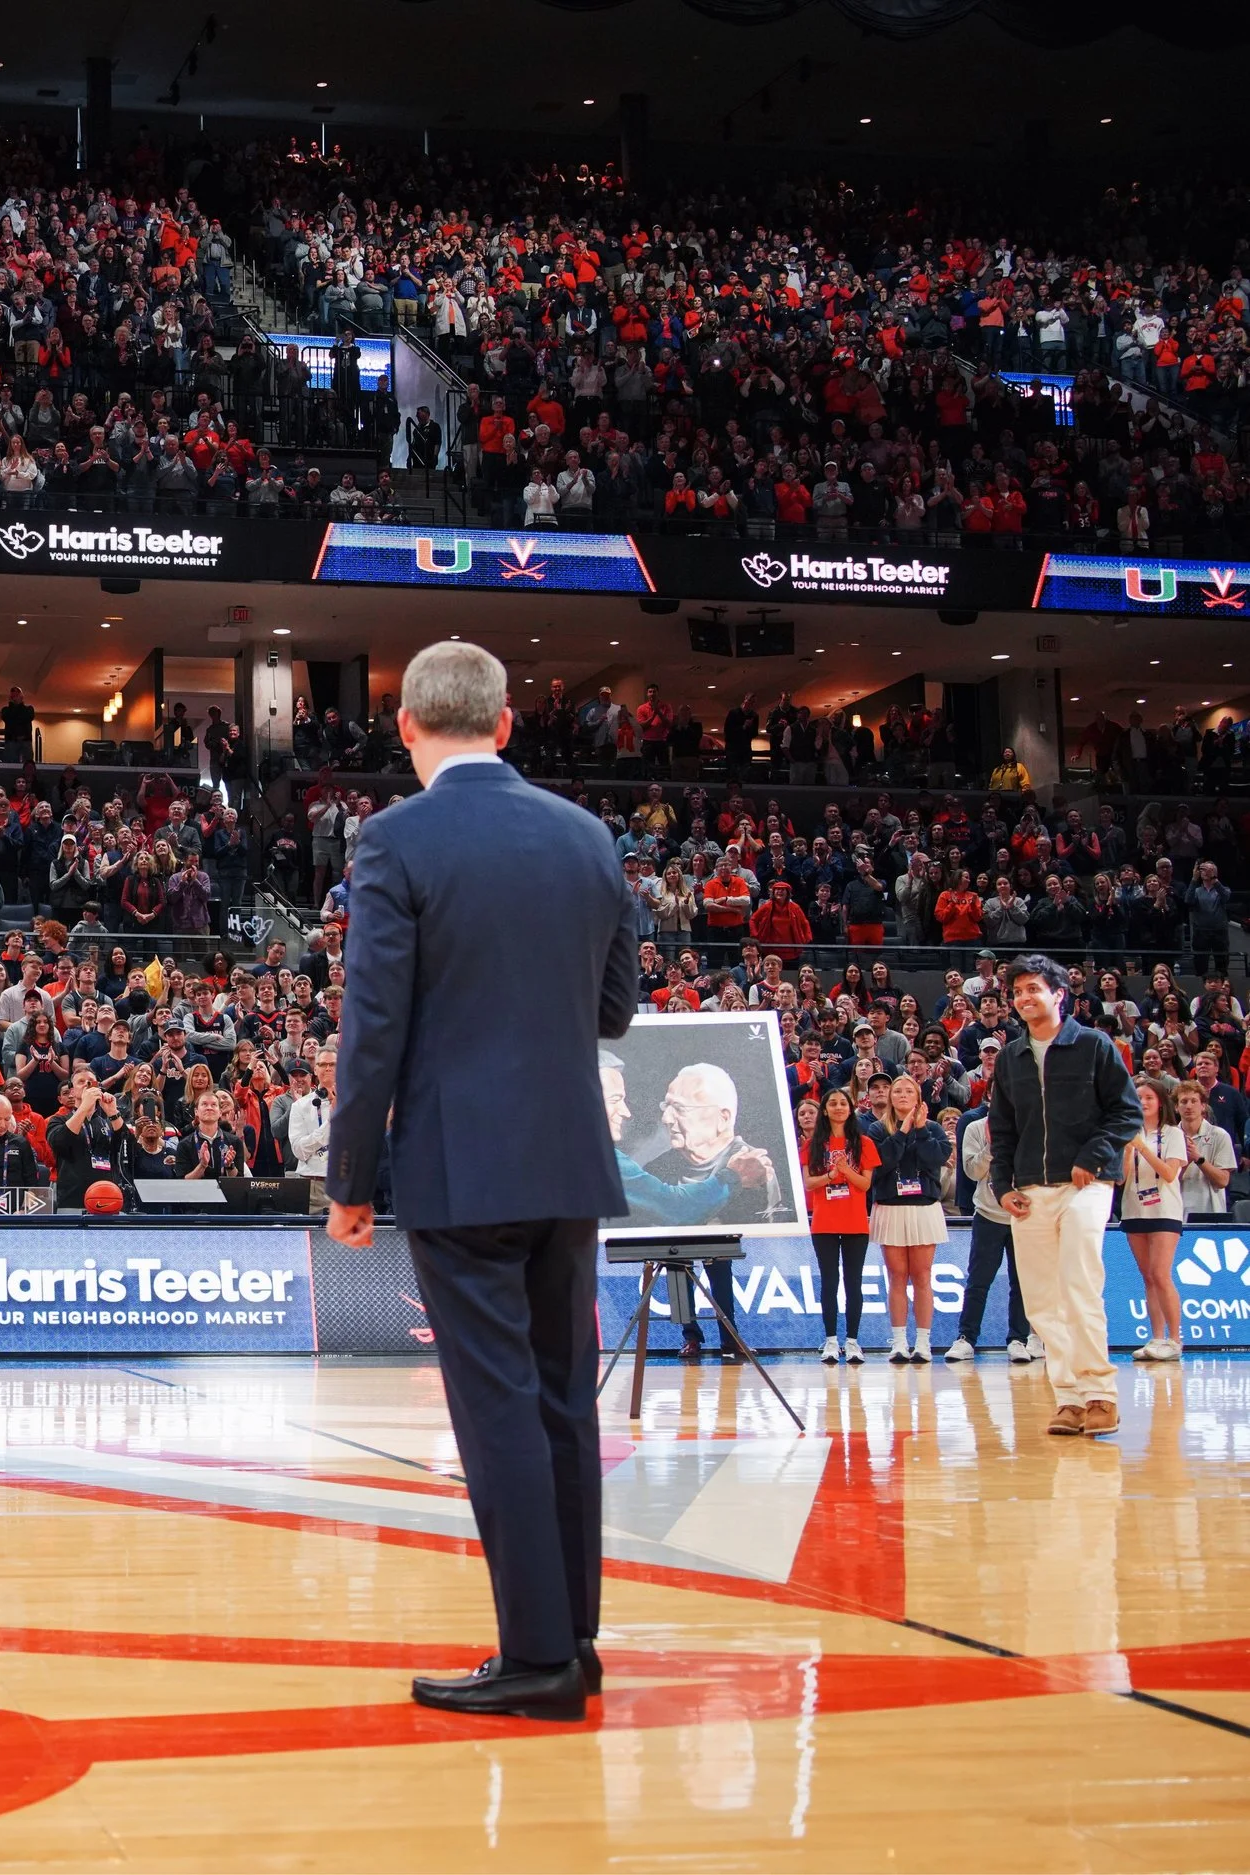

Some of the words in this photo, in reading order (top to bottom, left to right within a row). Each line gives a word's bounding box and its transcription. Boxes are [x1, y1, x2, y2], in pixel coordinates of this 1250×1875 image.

[49, 524, 132, 551] Harris
[50, 552, 78, 561] YOUR
[81, 554, 170, 565] NEIGHBORHOOD
[173, 557, 218, 567] MARKET
[416, 537, 472, 574] U
[790, 554, 867, 580] Harris
[792, 581, 818, 590] YOUR
[821, 582, 902, 593] NEIGHBORHOOD
[905, 585, 945, 595] MARKET
[1125, 568, 1177, 602] U
[233, 609, 249, 621] EXIT
[1041, 639, 1055, 649] EXIT
[33, 1311, 199, 1325] NEIGHBORHOOD
[205, 1311, 286, 1324] MARKET
